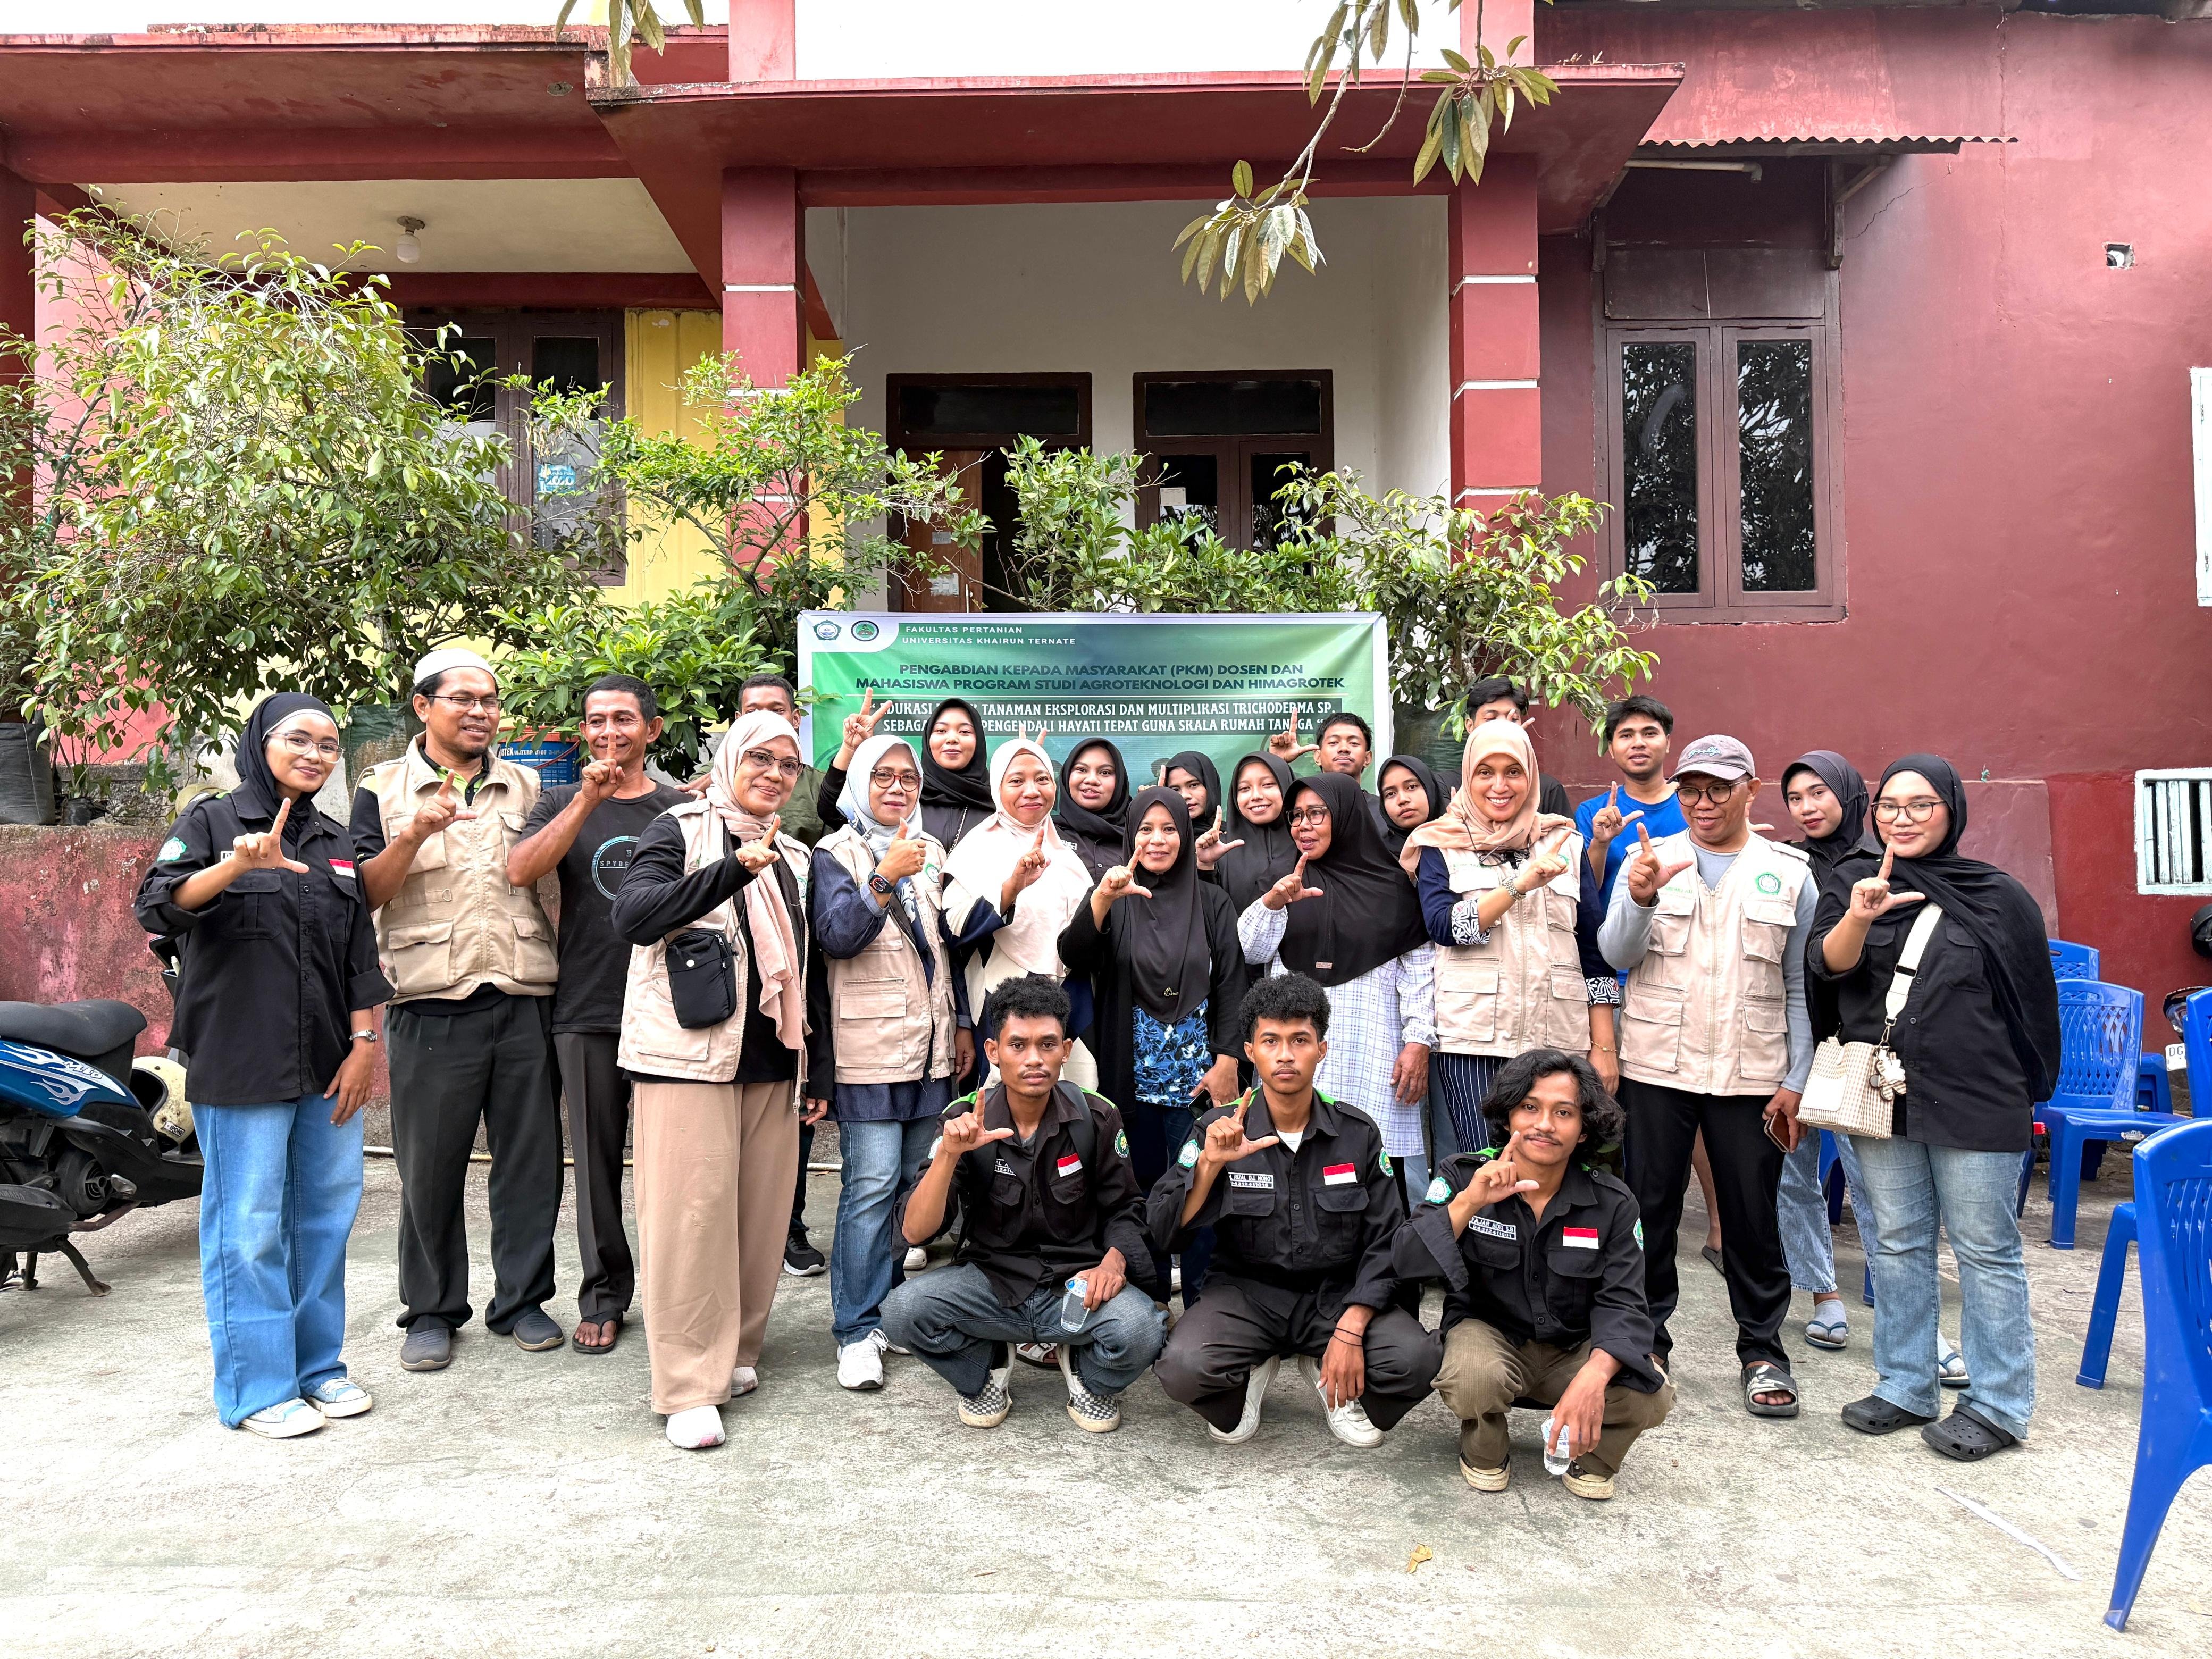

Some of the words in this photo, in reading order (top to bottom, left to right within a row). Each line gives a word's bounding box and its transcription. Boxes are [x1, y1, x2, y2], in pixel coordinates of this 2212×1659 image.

[900, 664, 998, 675] PENGABDIAN
[1002, 665, 1062, 675] KEPADA
[1066, 665, 1167, 675] MASYARAKAT
[1170, 664, 1213, 677] (PKM)
[1217, 664, 1268, 675] DOSEN
[1271, 664, 1303, 674] DAN
[856, 678, 950, 690] MAHASISWA
[953, 679, 1032, 690] PROGRAM
[1034, 680, 1076, 690] STUDI
[1080, 679, 1208, 690] AGROTEKNOLOGI
[1213, 679, 1244, 689] DAN
[1248, 678, 1345, 689] HIMAGROTEK
[880, 703, 932, 715] DUKASI
[982, 704, 1040, 716] TANAMAN
[1045, 704, 1116, 716] EKSPLORASI
[1119, 703, 1144, 715] DAN
[1149, 703, 1229, 715] MULTIPLIKASI
[1317, 702, 1336, 713] SP.
[983, 720, 1054, 732] PENGENDALI
[1058, 720, 1100, 732] HAYATI
[1104, 720, 1138, 732] TEPAT
[1142, 720, 1175, 732] GUNA
[1178, 719, 1217, 731] SKALA
[1221, 719, 1264, 731] RUMAH
[1268, 718, 1313, 730] TANGA
[2169, 1046, 2184, 1057] DG
[1471, 1217, 1490, 1227] FAJAR
